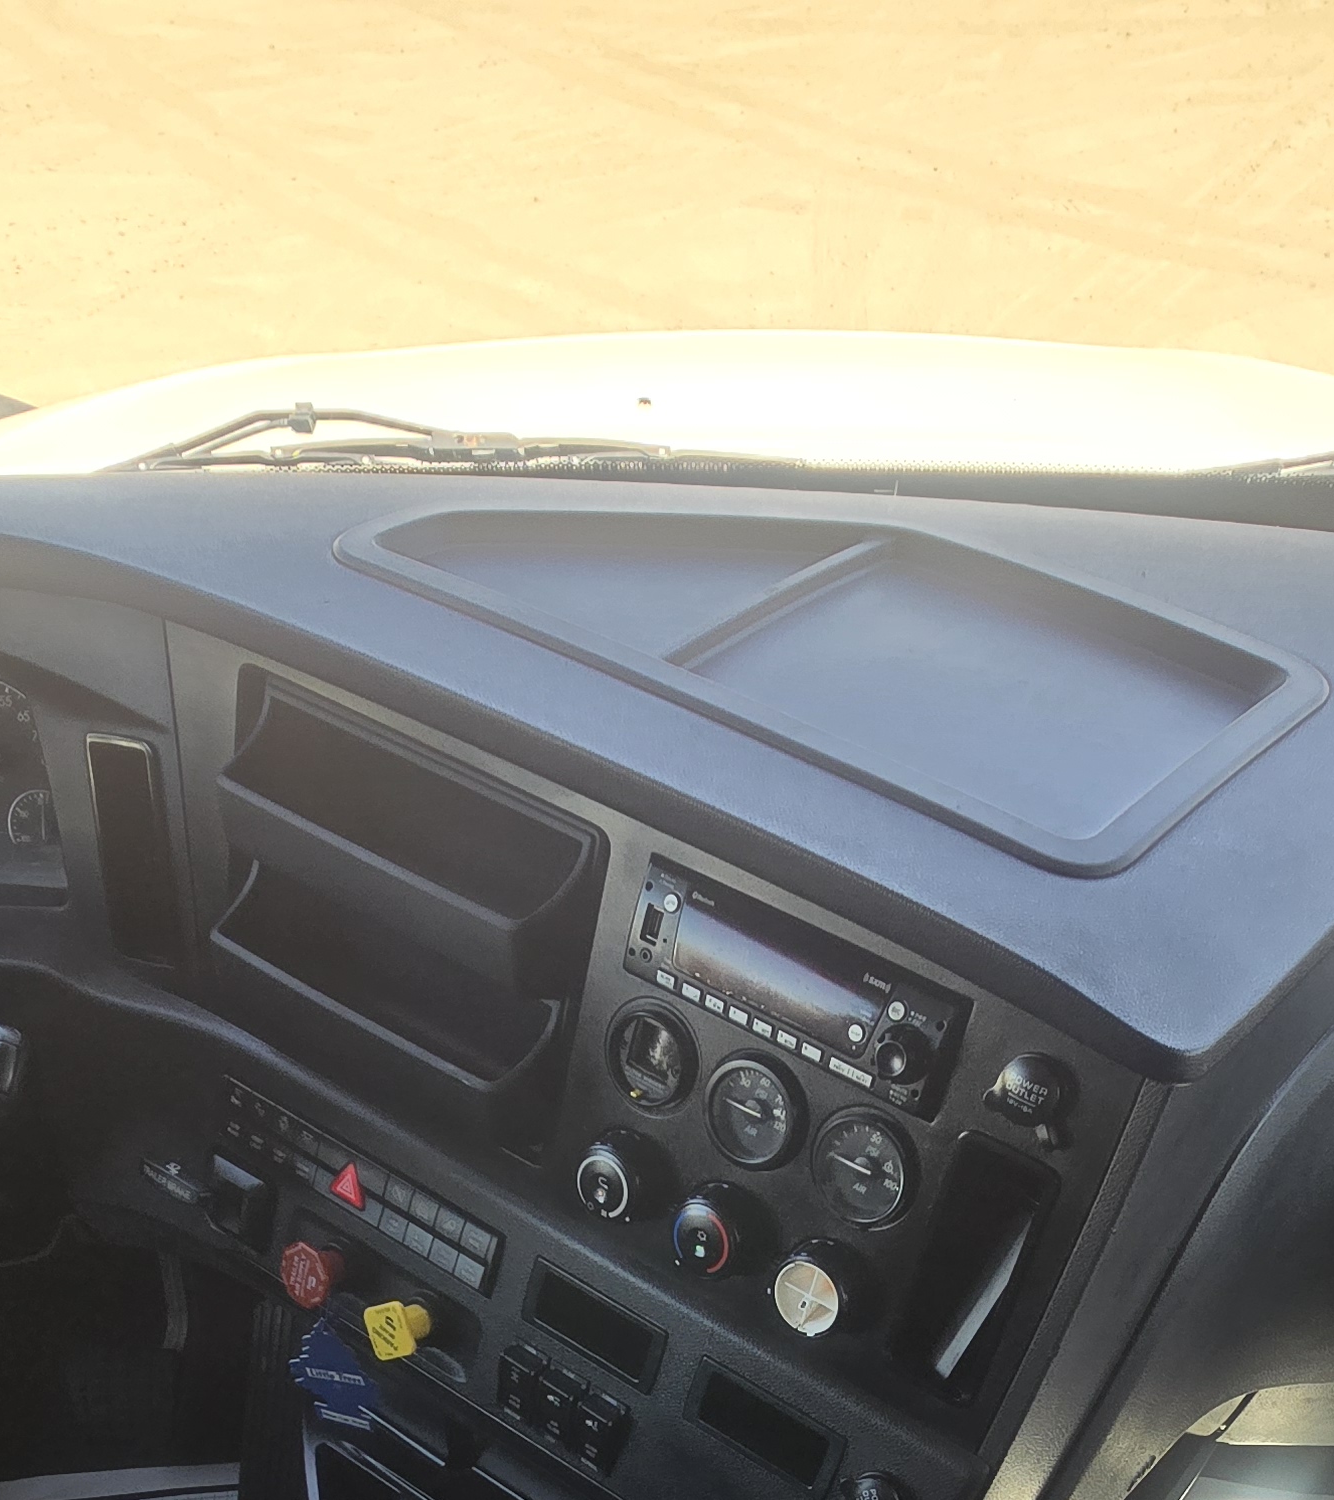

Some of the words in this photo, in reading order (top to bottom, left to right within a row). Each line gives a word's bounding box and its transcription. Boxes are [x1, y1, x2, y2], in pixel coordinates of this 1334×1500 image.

[0, 695, 12, 708] 55
[17, 710, 30, 722] 65
[1005, 1081, 1044, 1105] OUTLET
[853, 1182, 867, 1195] AIR
